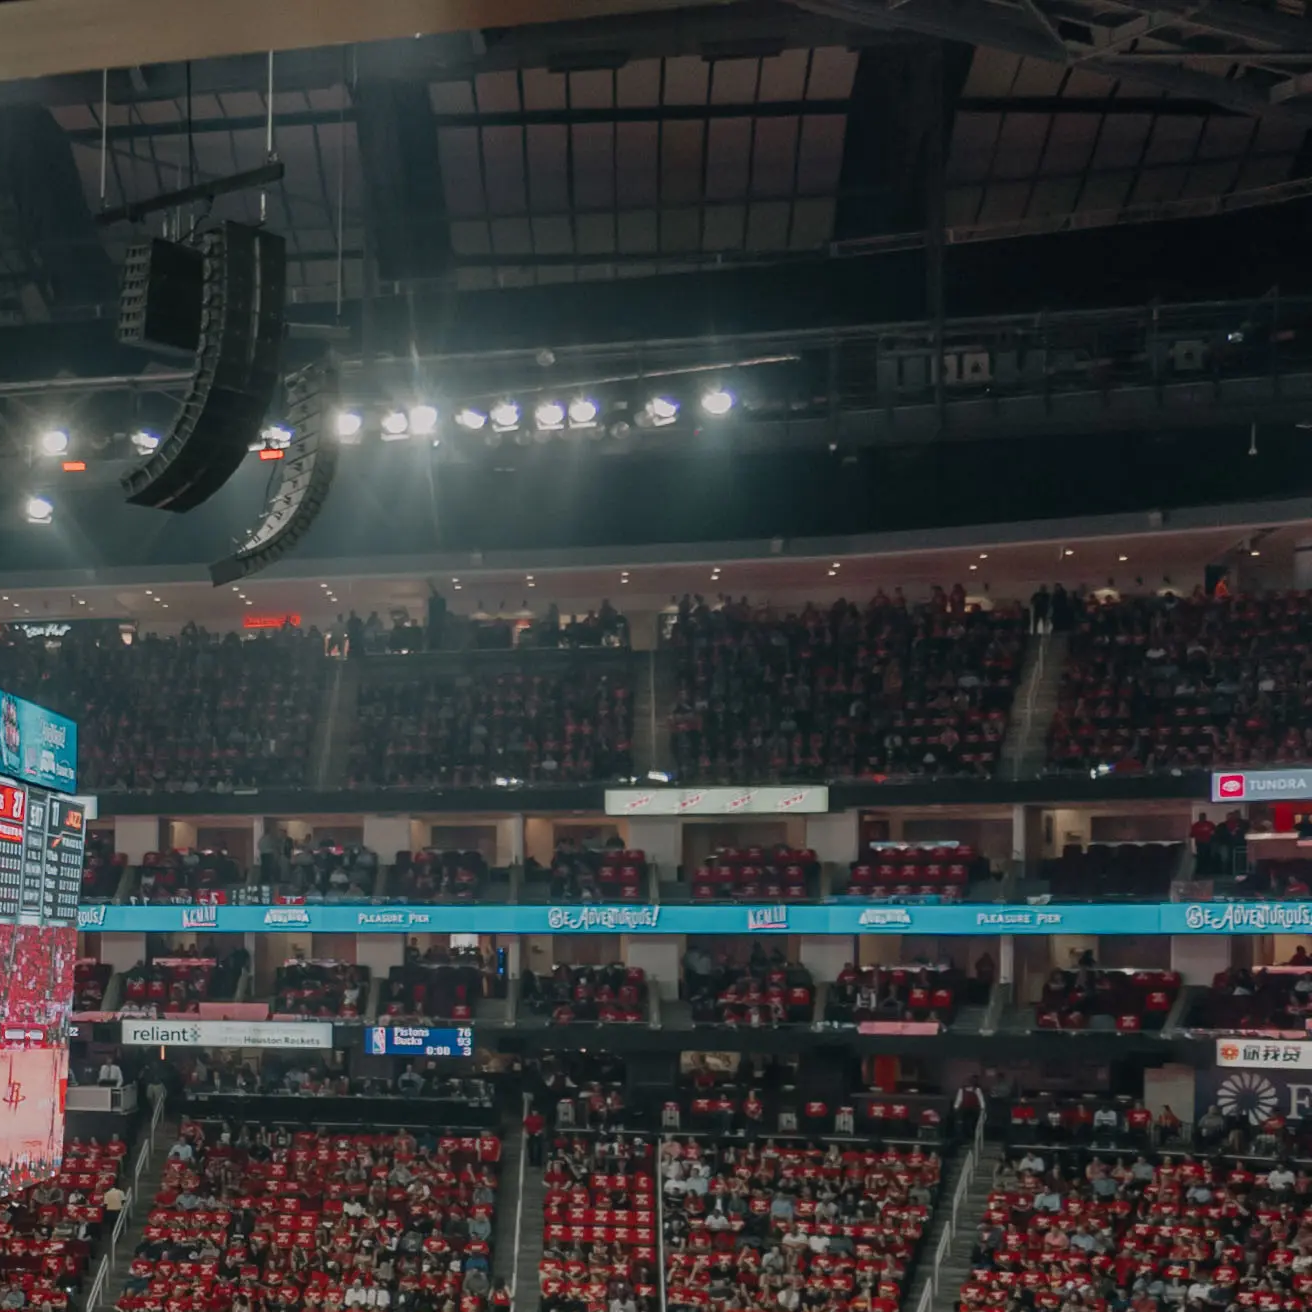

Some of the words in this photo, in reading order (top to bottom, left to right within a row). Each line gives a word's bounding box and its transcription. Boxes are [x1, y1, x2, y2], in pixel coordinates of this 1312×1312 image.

[1249, 778, 1306, 790] TUNDRA
[358, 913, 403, 924] PLEASURE
[408, 913, 429, 923] PIER
[548, 907, 570, 927] BE
[570, 905, 660, 929] ADVENTUROUS!
[977, 913, 1030, 924] PLEASURE
[1036, 913, 1061, 924] PIER
[1186, 905, 1211, 929] BE
[133, 1025, 188, 1043] reliant
[394, 1028, 429, 1037] Pistons
[457, 1028, 471, 1037] 76
[244, 1036, 281, 1045] Houston
[284, 1036, 320, 1046] Rockets
[457, 1038, 471, 1047] 93
[463, 1047, 471, 1056] 3
